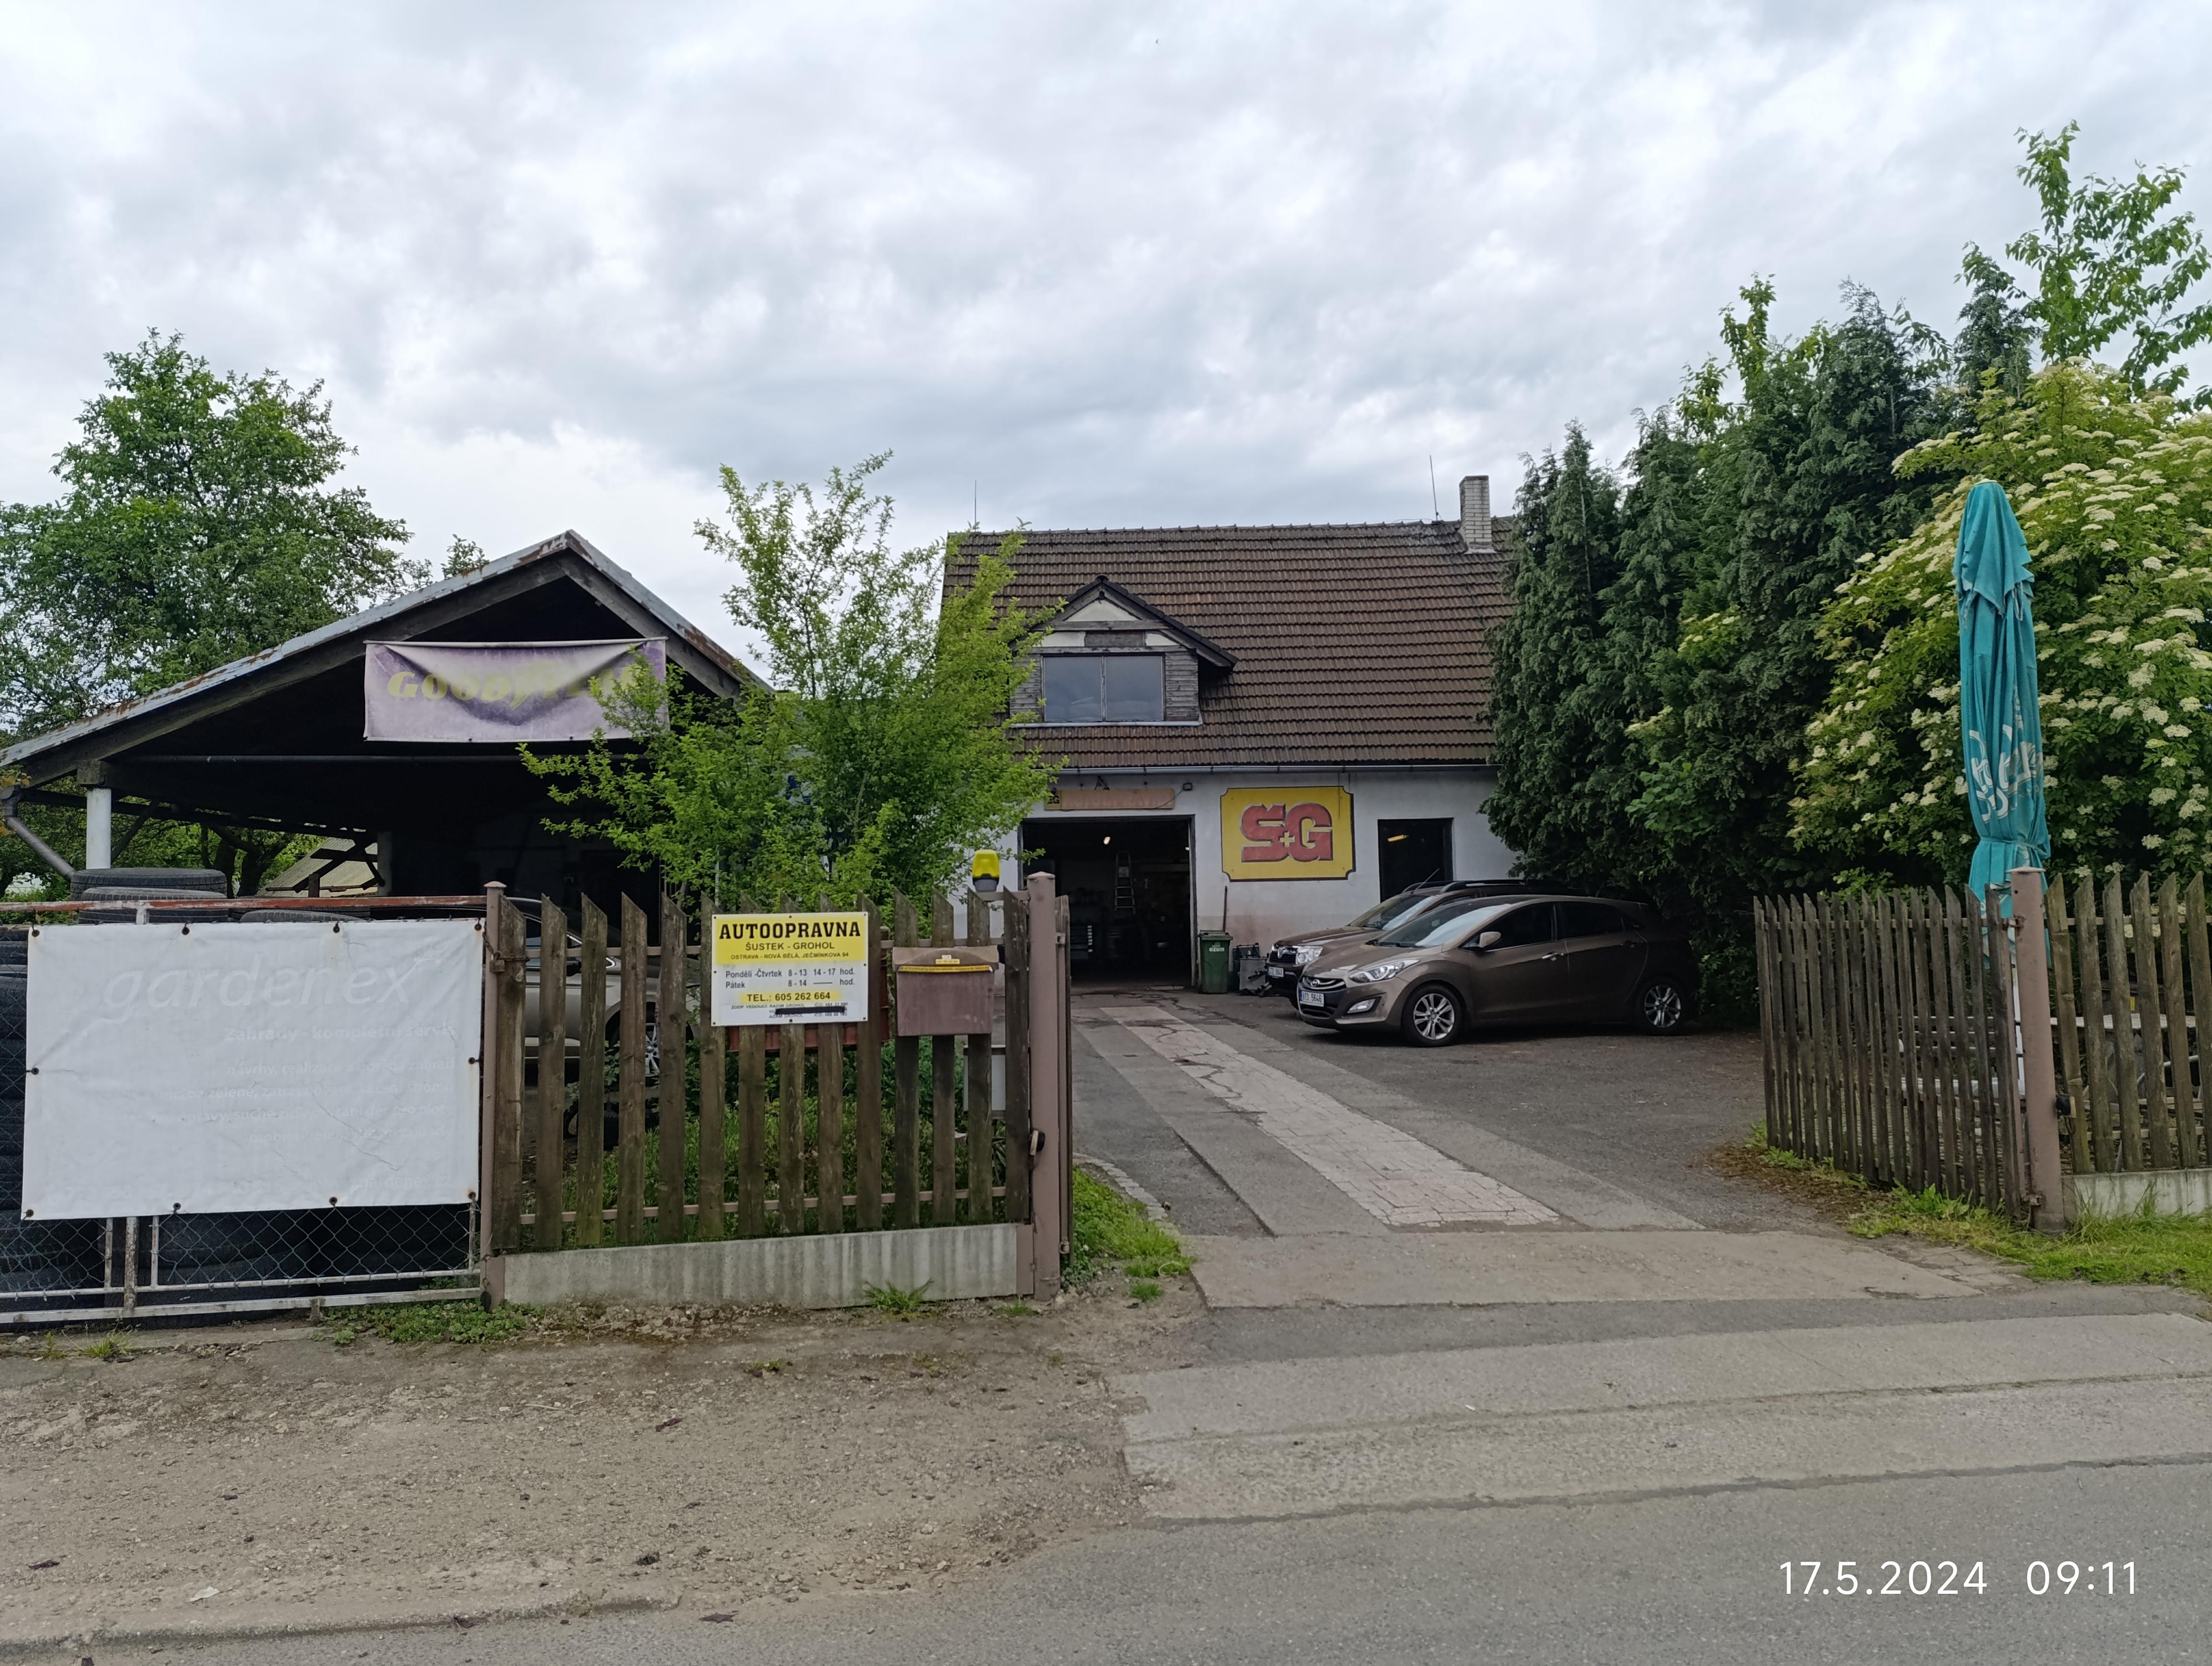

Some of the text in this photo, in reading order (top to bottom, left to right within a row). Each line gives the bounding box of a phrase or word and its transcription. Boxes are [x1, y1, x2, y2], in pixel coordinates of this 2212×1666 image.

[387, 661, 643, 709] GOODYE
[720, 922, 861, 939] AUTOOPRAVNA
[746, 941, 784, 951] ŠUSTEK
[100, 950, 413, 1023] gardenex
[725, 981, 745, 989] Pátek
[224, 1025, 298, 1042] Zahrady
